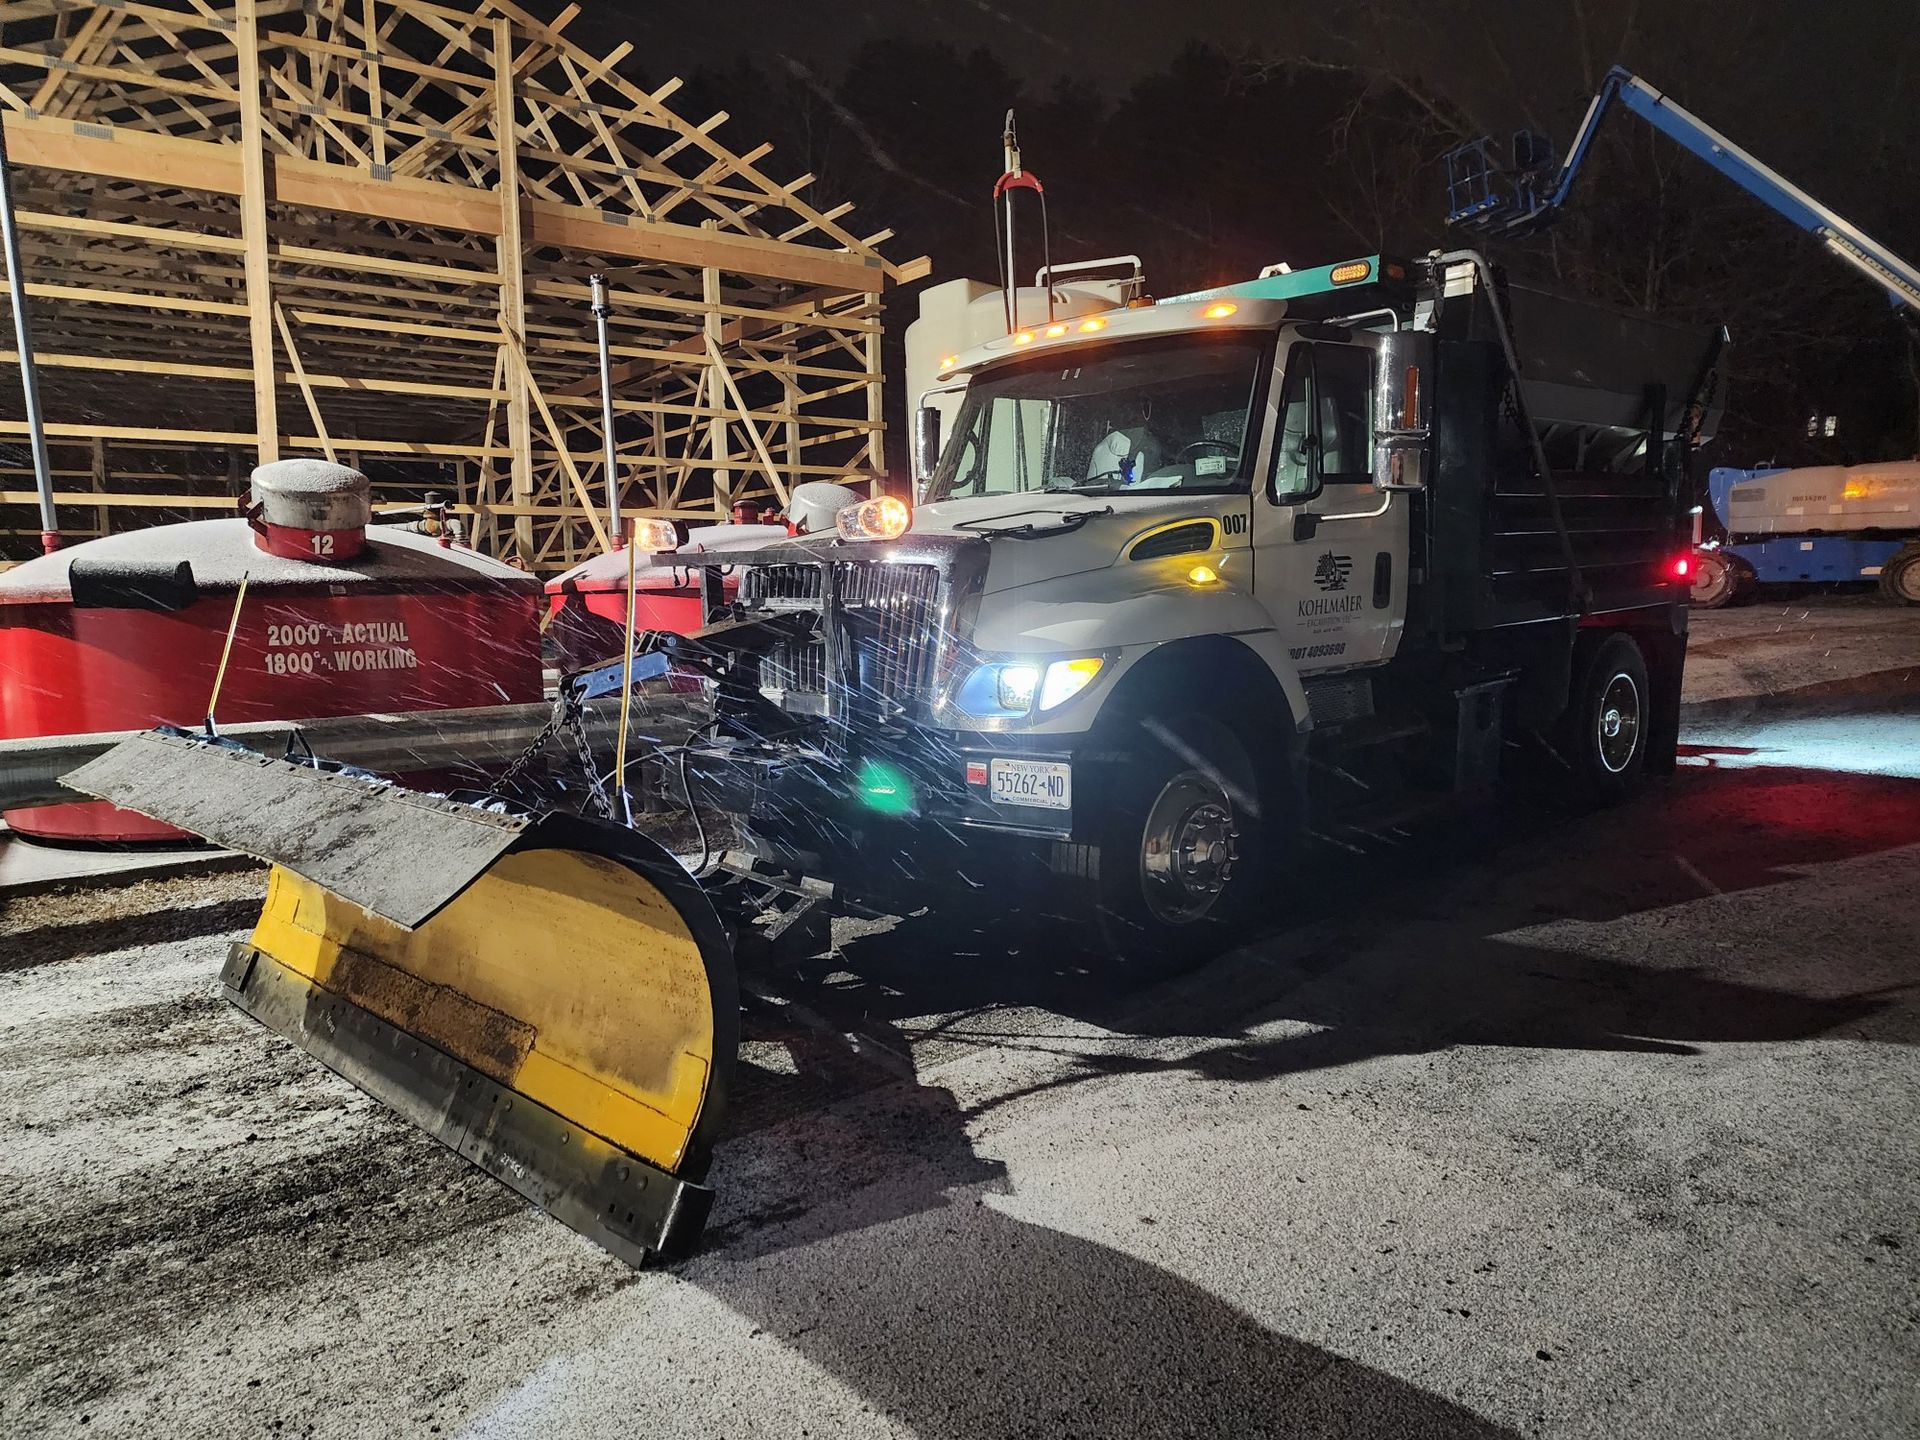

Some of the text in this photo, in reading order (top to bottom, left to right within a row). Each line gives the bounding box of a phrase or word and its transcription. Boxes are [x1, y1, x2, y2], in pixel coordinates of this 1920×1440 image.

[1222, 513, 1247, 535] 007
[311, 534, 334, 555] 12
[1298, 595, 1362, 617] KOHLMAIER
[267, 624, 320, 646] 2000
[342, 622, 409, 644] ACTUAL
[264, 652, 314, 675] 1800
[334, 648, 417, 672] WORKING
[1011, 763, 1050, 774] NEW YORK
[997, 771, 1065, 798] 55262 ND
[1012, 796, 1049, 804] COMMERCIAL
